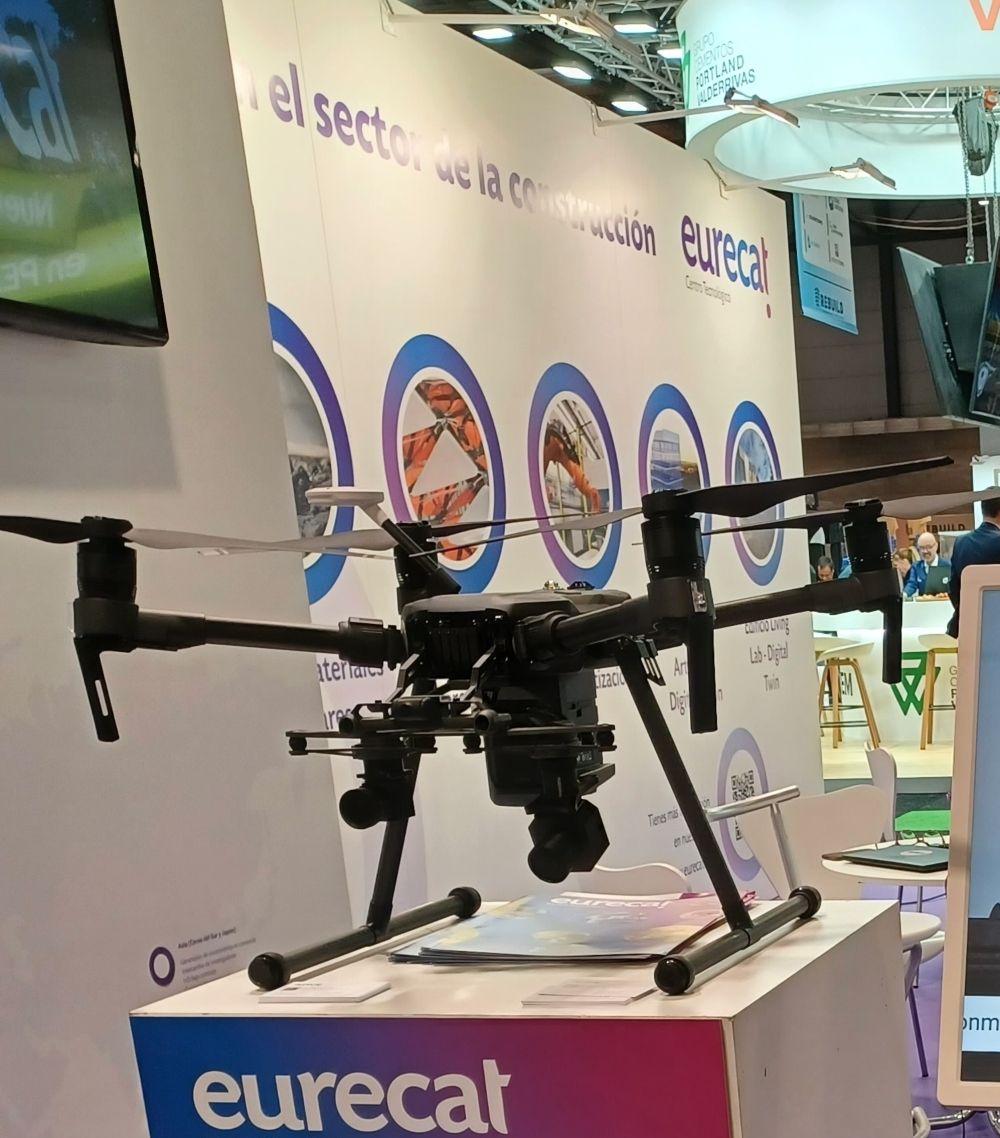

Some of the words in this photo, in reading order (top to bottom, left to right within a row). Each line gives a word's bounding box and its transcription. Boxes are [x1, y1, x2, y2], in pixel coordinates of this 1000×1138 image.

[696, 55, 744, 89] PORTLAND
[269, 62, 305, 127] el
[314, 93, 422, 171] sector
[478, 143, 504, 202] la
[681, 215, 771, 318] eurecat
[749, 646, 763, 664] Lab
[767, 642, 789, 666] Digital
[763, 674, 780, 692] Twin
